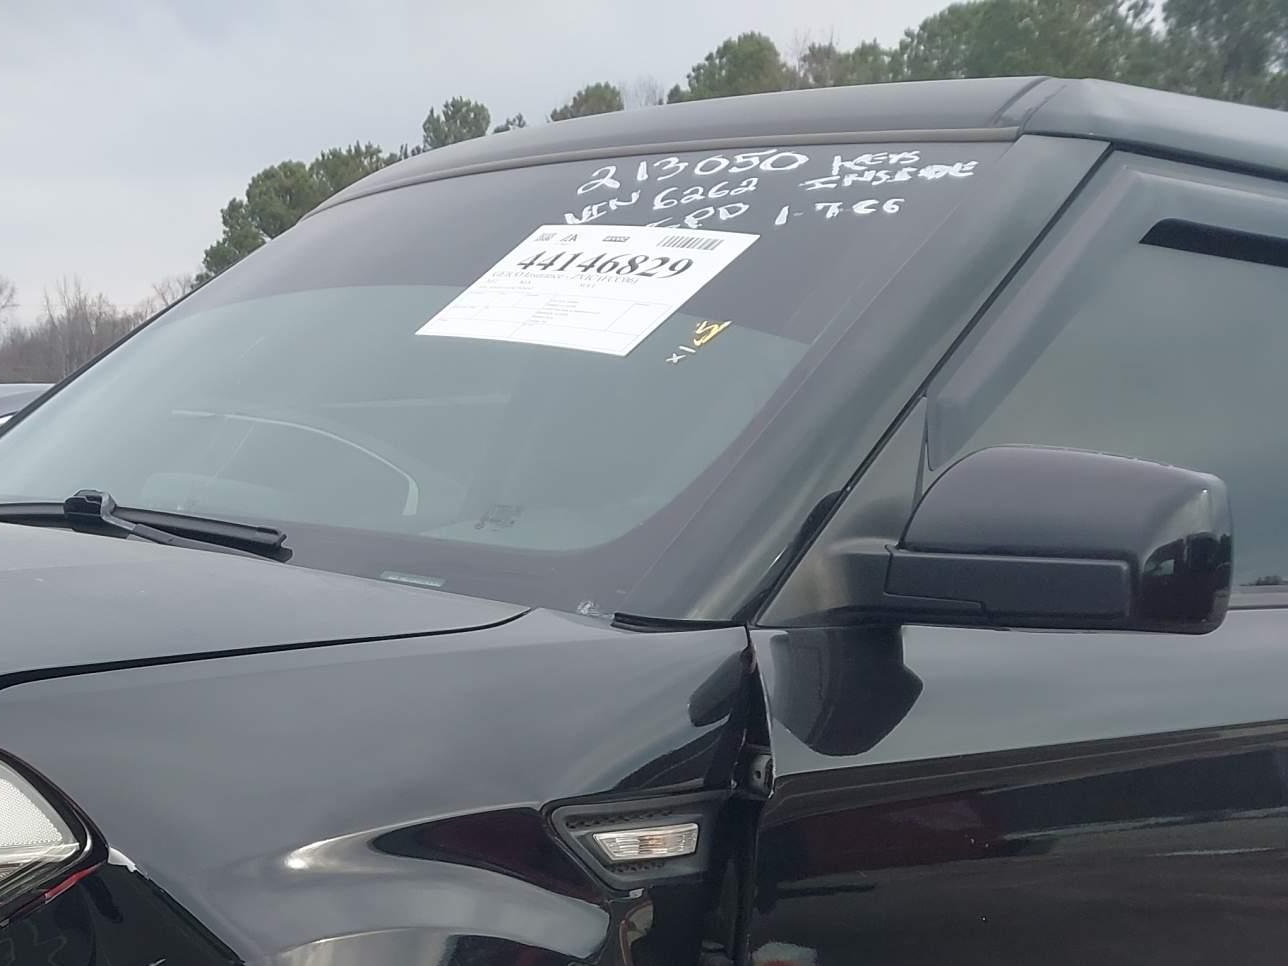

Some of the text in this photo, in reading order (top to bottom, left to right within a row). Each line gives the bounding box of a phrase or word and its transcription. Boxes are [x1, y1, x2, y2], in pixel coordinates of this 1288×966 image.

[576, 149, 810, 195] 213050
[832, 150, 921, 175] KEYS
[651, 177, 759, 211] 6262
[516, 250, 695, 279] 44146829
